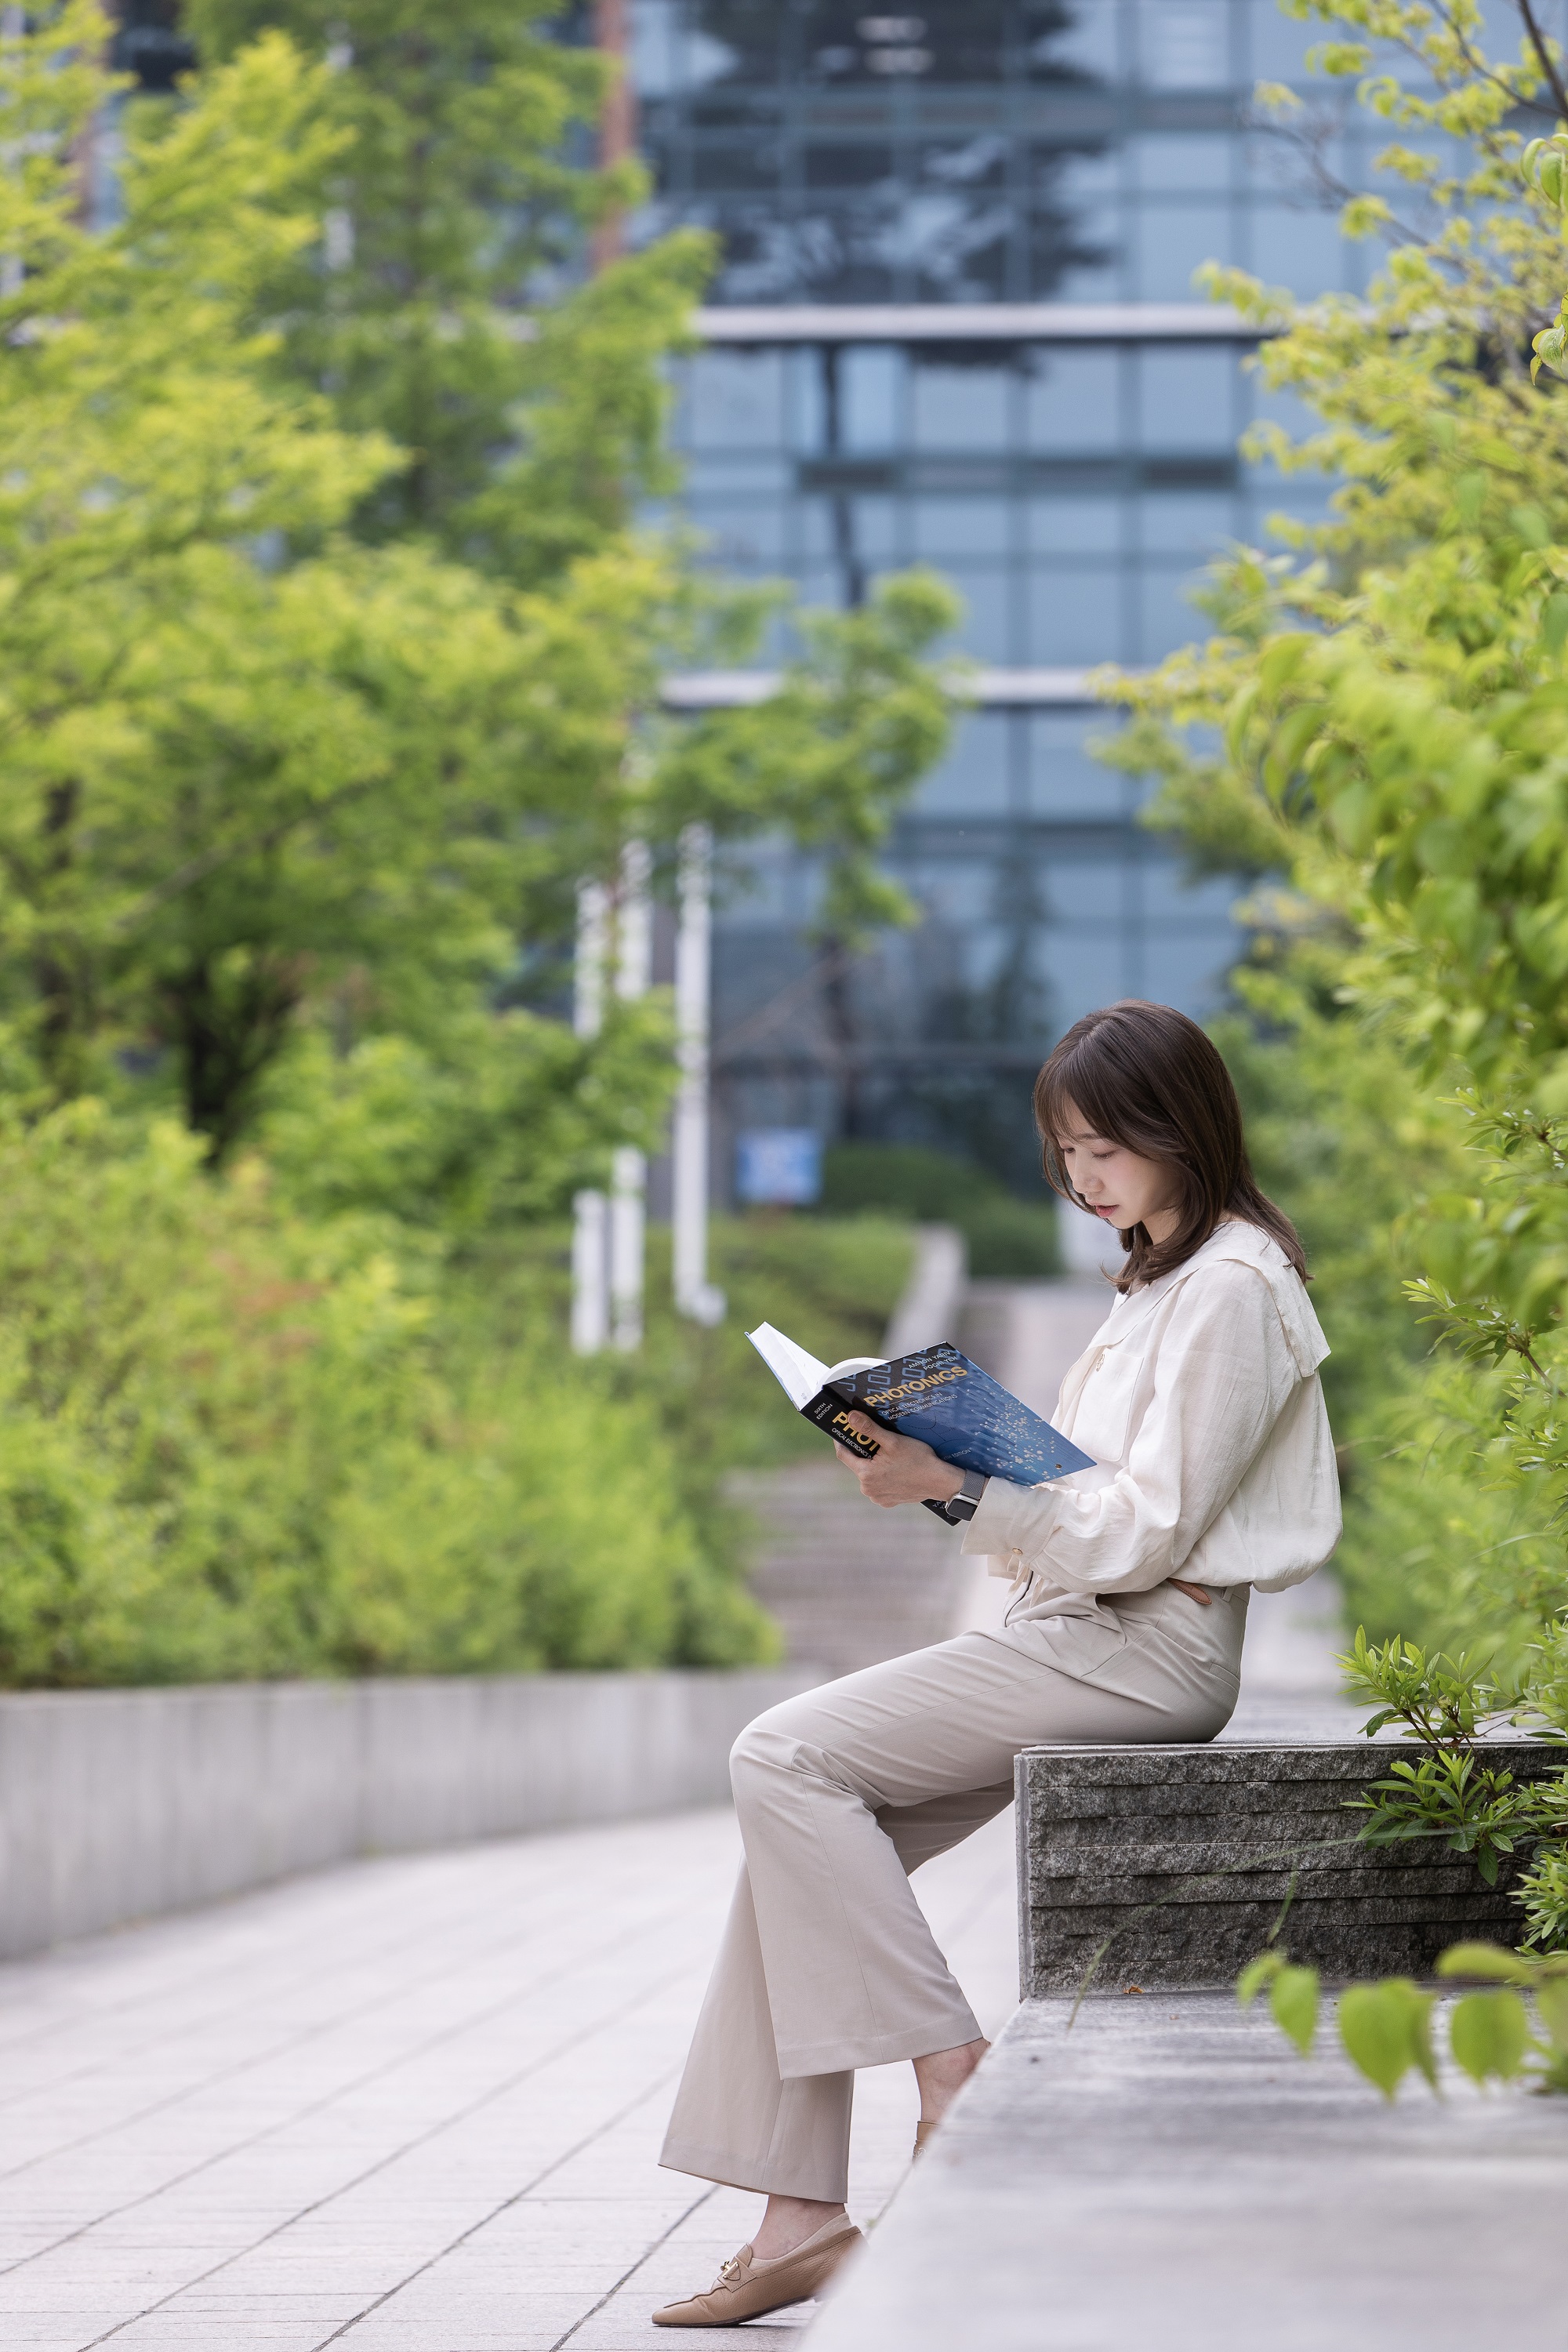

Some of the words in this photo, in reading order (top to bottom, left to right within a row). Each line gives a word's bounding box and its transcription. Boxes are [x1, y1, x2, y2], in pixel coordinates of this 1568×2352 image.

[909, 1357, 932, 1369] AMNON
[932, 1351, 951, 1360] YARIV
[863, 1366, 967, 1407] PHOTONICS
[814, 1402, 826, 1414] SIXTH
[816, 1403, 833, 1420] EDITION
[881, 1406, 902, 1416] OPTICAL
[902, 1394, 936, 1409] ELECTRONICS
[888, 1410, 910, 1421] MODERN
[909, 1394, 958, 1413] COMMUNICATIONS
[832, 1428, 848, 1442] OPTICAL
[846, 1439, 869, 1457] ELECTRONICS
[952, 1449, 971, 1457] EDITION
